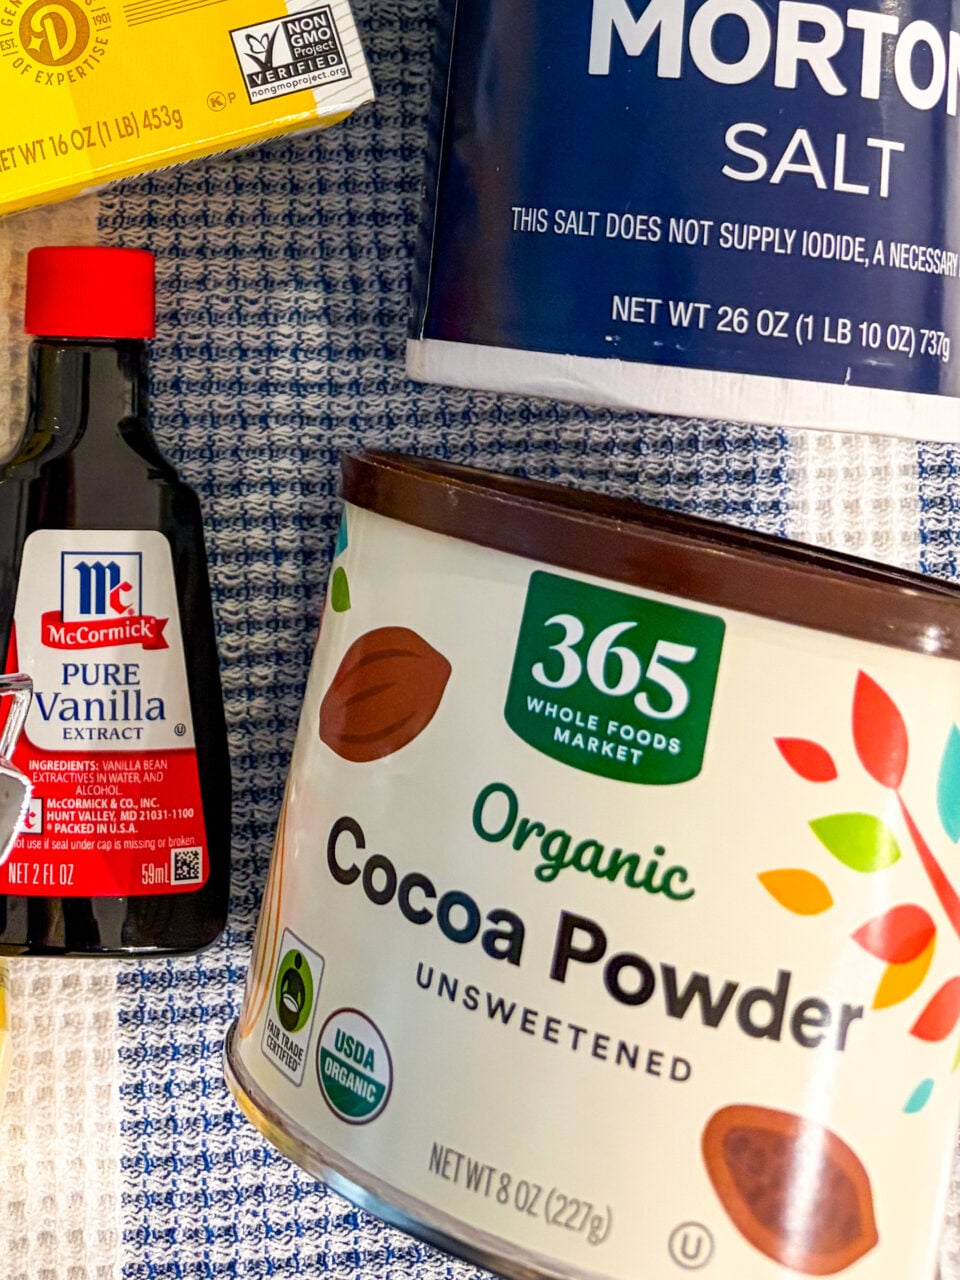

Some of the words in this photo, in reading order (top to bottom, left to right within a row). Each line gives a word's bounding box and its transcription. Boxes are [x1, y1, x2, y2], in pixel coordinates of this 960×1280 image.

[287, 14, 326, 35] NON
[290, 26, 330, 46] GMO
[12, 57, 30, 76] OF
[35, 36, 110, 86] EXPERTISE
[294, 39, 335, 58] Project
[251, 54, 339, 85] VERIFIED
[251, 66, 347, 99] nongmoproject.org
[19, 139, 46, 165] WT
[49, 134, 68, 156] 16
[72, 126, 95, 150] OZ
[98, 121, 112, 149] (1
[117, 110, 141, 142] LB)
[142, 104, 184, 132] 453g
[721, 122, 905, 198] SALT
[511, 206, 548, 233] THIS
[553, 210, 599, 237] SALT
[606, 213, 661, 242] DOES
[668, 218, 713, 246] NOT
[720, 222, 796, 256] SUPPLY
[802, 231, 869, 268] IODIDE,
[873, 240, 884, 266] A
[890, 242, 958, 277] NECESSARY
[612, 295, 662, 324] NET
[668, 301, 710, 328] WT
[717, 306, 748, 334] 26
[756, 309, 788, 338] OZ
[796, 314, 814, 345] (1
[823, 317, 852, 345] LB
[859, 321, 881, 348] 10
[886, 324, 915, 358] OZ)
[920, 329, 950, 362] 737g
[47, 620, 154, 645] McCormick
[62, 663, 140, 686] PURE
[531, 613, 698, 721] 365
[34, 689, 166, 721] Vanilla
[63, 727, 144, 740] EXTRACT
[526, 695, 599, 730] WHOLE
[607, 719, 681, 756] FOODS
[553, 727, 644, 766] MARKET
[29, 760, 99, 771] INGREDIENTS:
[102, 760, 140, 770] VANILLA
[143, 760, 168, 769] BEAN
[33, 772, 94, 783] EXTRACTIVES
[97, 773, 106, 783] IN
[143, 772, 163, 782] AND
[47, 798, 108, 809] McCORMICK
[110, 798, 118, 808] &
[140, 798, 160, 808] INC.
[75, 785, 123, 796] ALCOHOL.
[47, 811, 75, 821] HUNT
[78, 811, 116, 822] VALLEY,
[120, 811, 137, 821] MD
[140, 808, 194, 820] 21031-1100
[54, 823, 94, 834] PACKED
[97, 824, 107, 833] IN
[110, 823, 138, 833] U.S.A.
[472, 782, 695, 902] Organic
[9, 863, 29, 884] NET
[33, 864, 39, 884] 2
[44, 864, 55, 885] FL
[59, 864, 74, 885] OZ
[142, 863, 169, 884] 59mL
[327, 815, 526, 967] Cocoa
[549, 909, 865, 1052] Powder
[267, 1019, 281, 1039] FAIR
[281, 1032, 304, 1060] TRADE
[415, 962, 692, 1082] UNSWEETENED
[267, 1035, 298, 1072] CERTIFIED
[334, 1028, 375, 1072] USDA
[325, 1057, 377, 1103] ORGANIC
[428, 1141, 464, 1183] NET
[466, 1157, 496, 1196] WT
[496, 1172, 509, 1204] 8
[515, 1179, 543, 1217] OZ
[544, 1187, 613, 1246] (227g)
